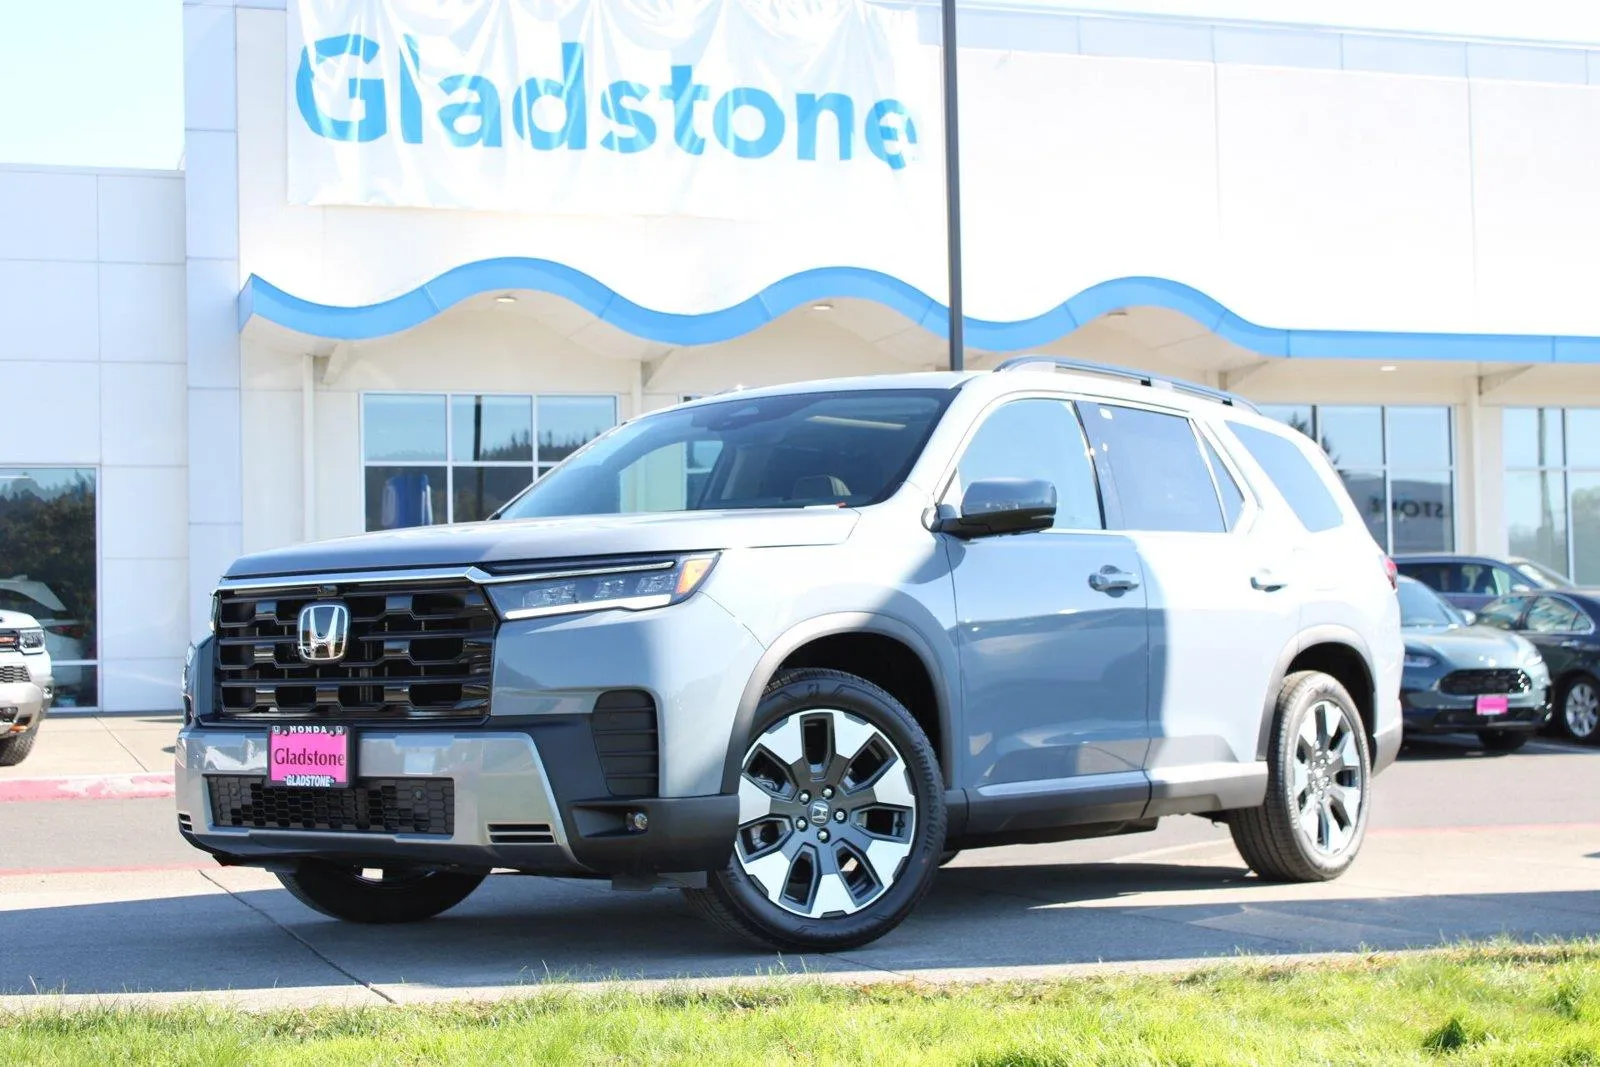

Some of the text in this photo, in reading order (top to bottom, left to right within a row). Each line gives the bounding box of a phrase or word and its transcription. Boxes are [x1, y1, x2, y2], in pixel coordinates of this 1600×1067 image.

[295, 33, 917, 170] Gladstone
[289, 725, 328, 734] HONDA
[274, 748, 345, 766] Gladstone
[286, 774, 331, 787] GLADSTONE
